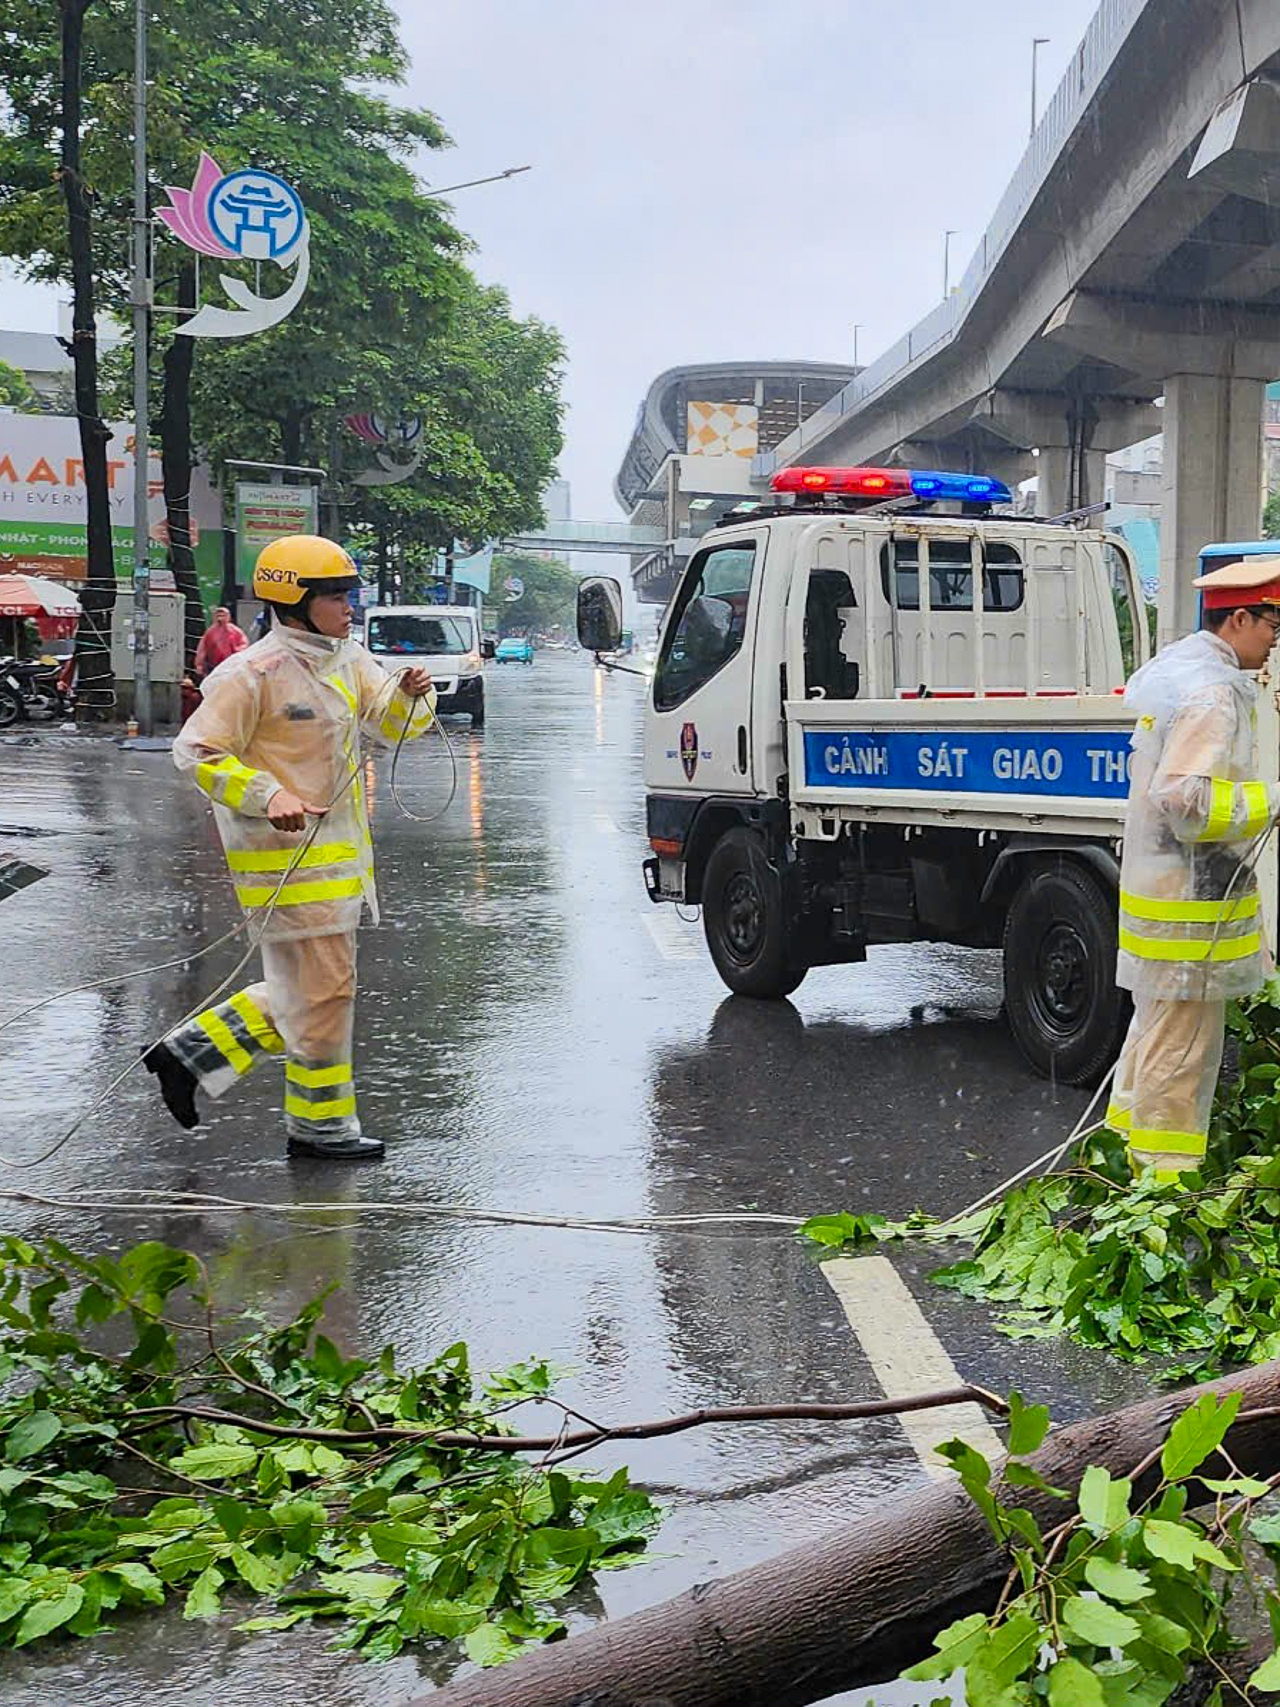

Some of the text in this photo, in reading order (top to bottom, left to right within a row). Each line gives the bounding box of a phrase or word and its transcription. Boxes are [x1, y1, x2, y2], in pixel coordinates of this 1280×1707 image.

[257, 567, 297, 584] CSGT
[824, 736, 888, 776] CẢNH
[917, 741, 968, 778] SÁT
[992, 747, 1063, 781] GIAO
